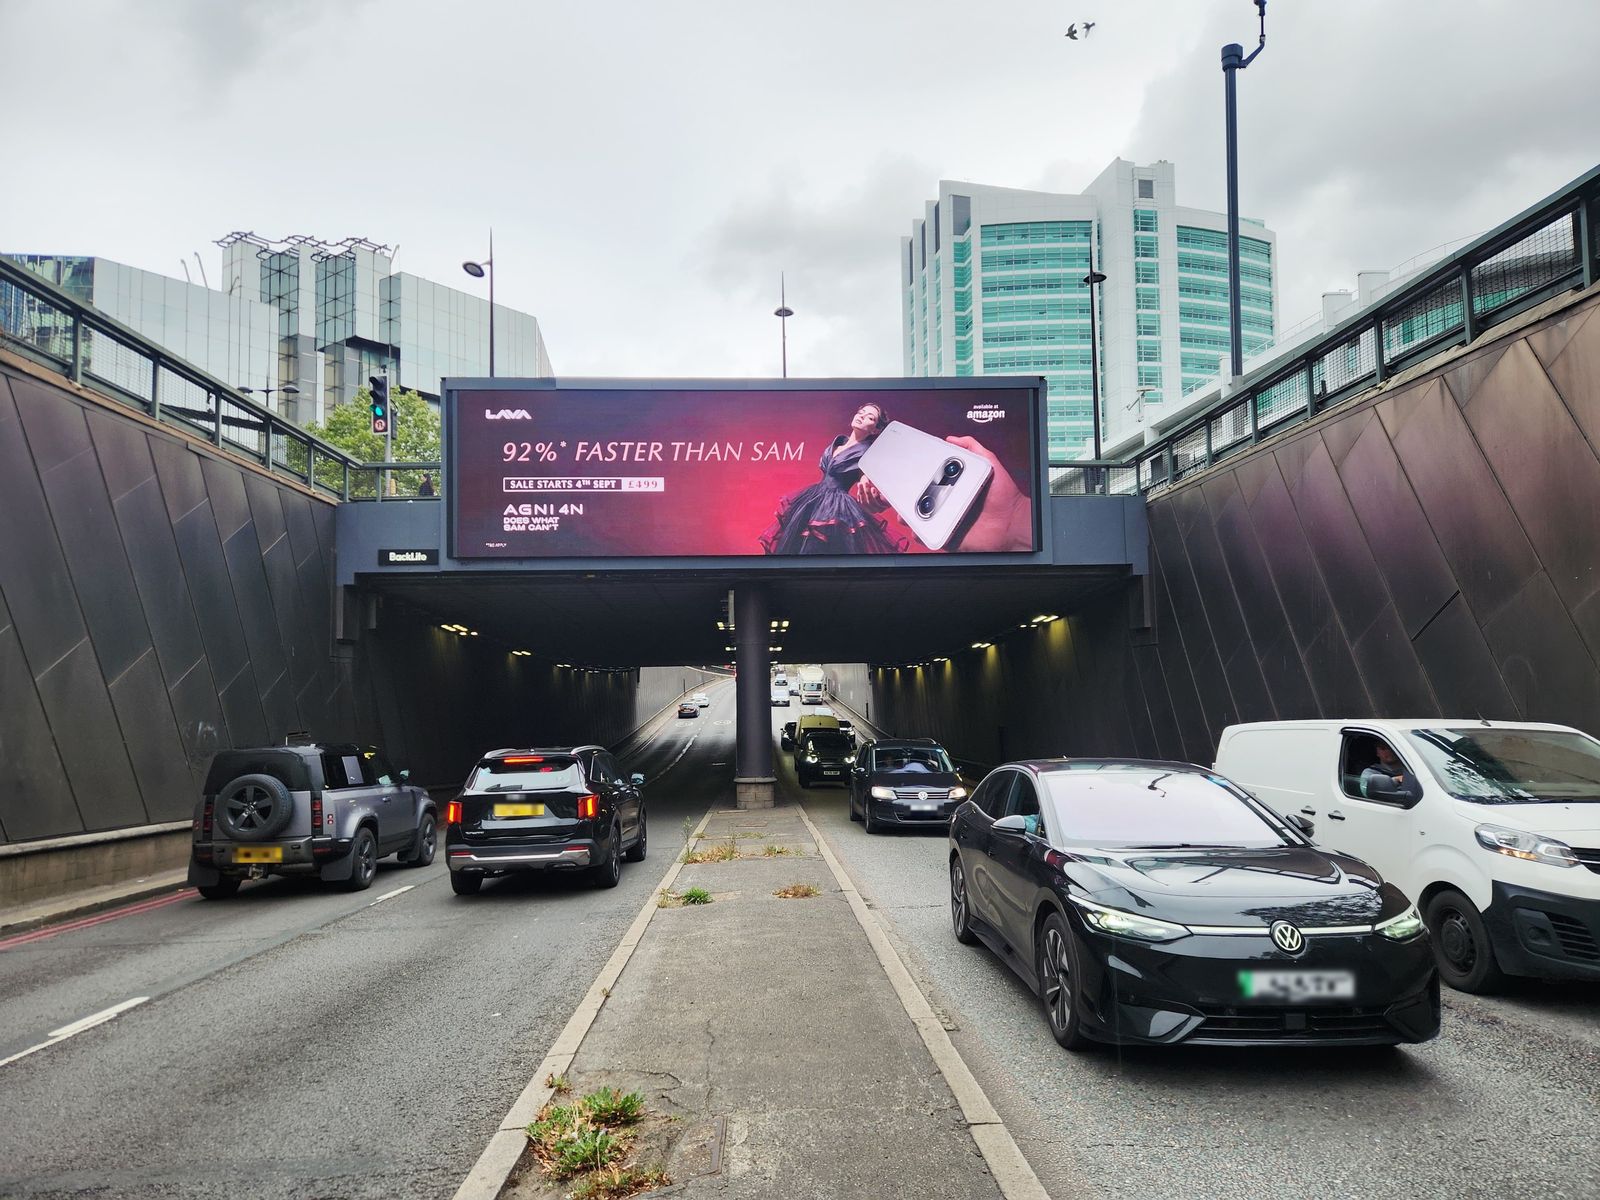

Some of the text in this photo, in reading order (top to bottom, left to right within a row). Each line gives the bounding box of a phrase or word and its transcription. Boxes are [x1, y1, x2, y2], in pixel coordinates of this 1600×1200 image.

[485, 409, 532, 420] LAVA
[966, 410, 1006, 423] amazon
[575, 442, 663, 462] FASTER
[671, 442, 743, 462] THAN
[751, 442, 805, 462] SAM
[510, 479, 658, 489] SALE STARTS 4TH SEPT £499
[503, 503, 584, 515] AGNI 4N
[503, 517, 560, 525] DOES WHAT
[503, 524, 559, 532] SAM CAN'T
